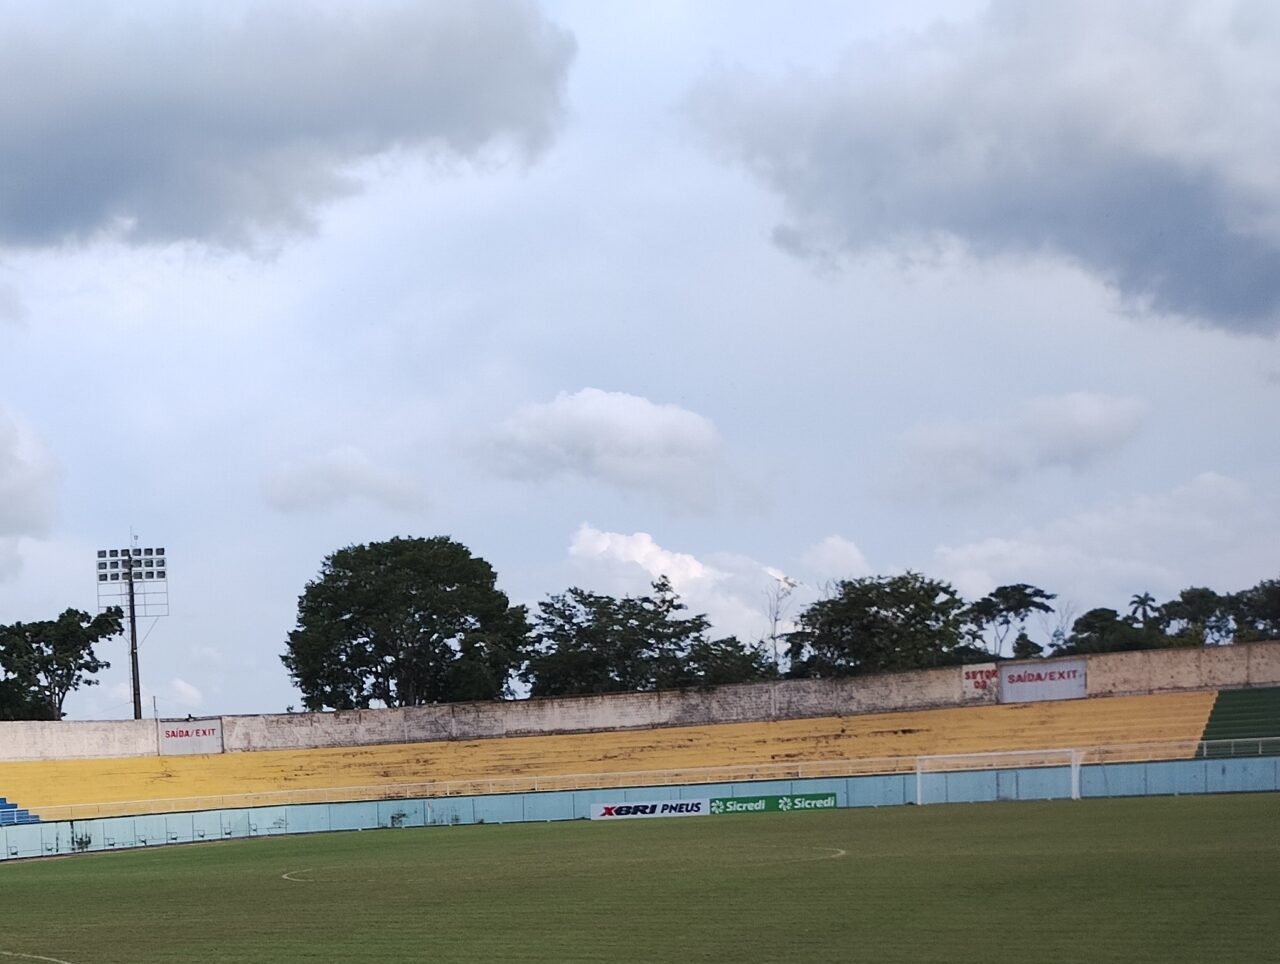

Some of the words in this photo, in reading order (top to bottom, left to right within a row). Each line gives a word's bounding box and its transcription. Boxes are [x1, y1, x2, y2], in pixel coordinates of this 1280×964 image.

[1007, 669, 1078, 684] SAÍDA/EXIT
[165, 728, 216, 738] SAÍDA/EXIT
[725, 799, 765, 811] Sicredi
[794, 796, 836, 808] Sicredi
[601, 804, 657, 816] XBRI
[660, 802, 701, 814] PNEUS
